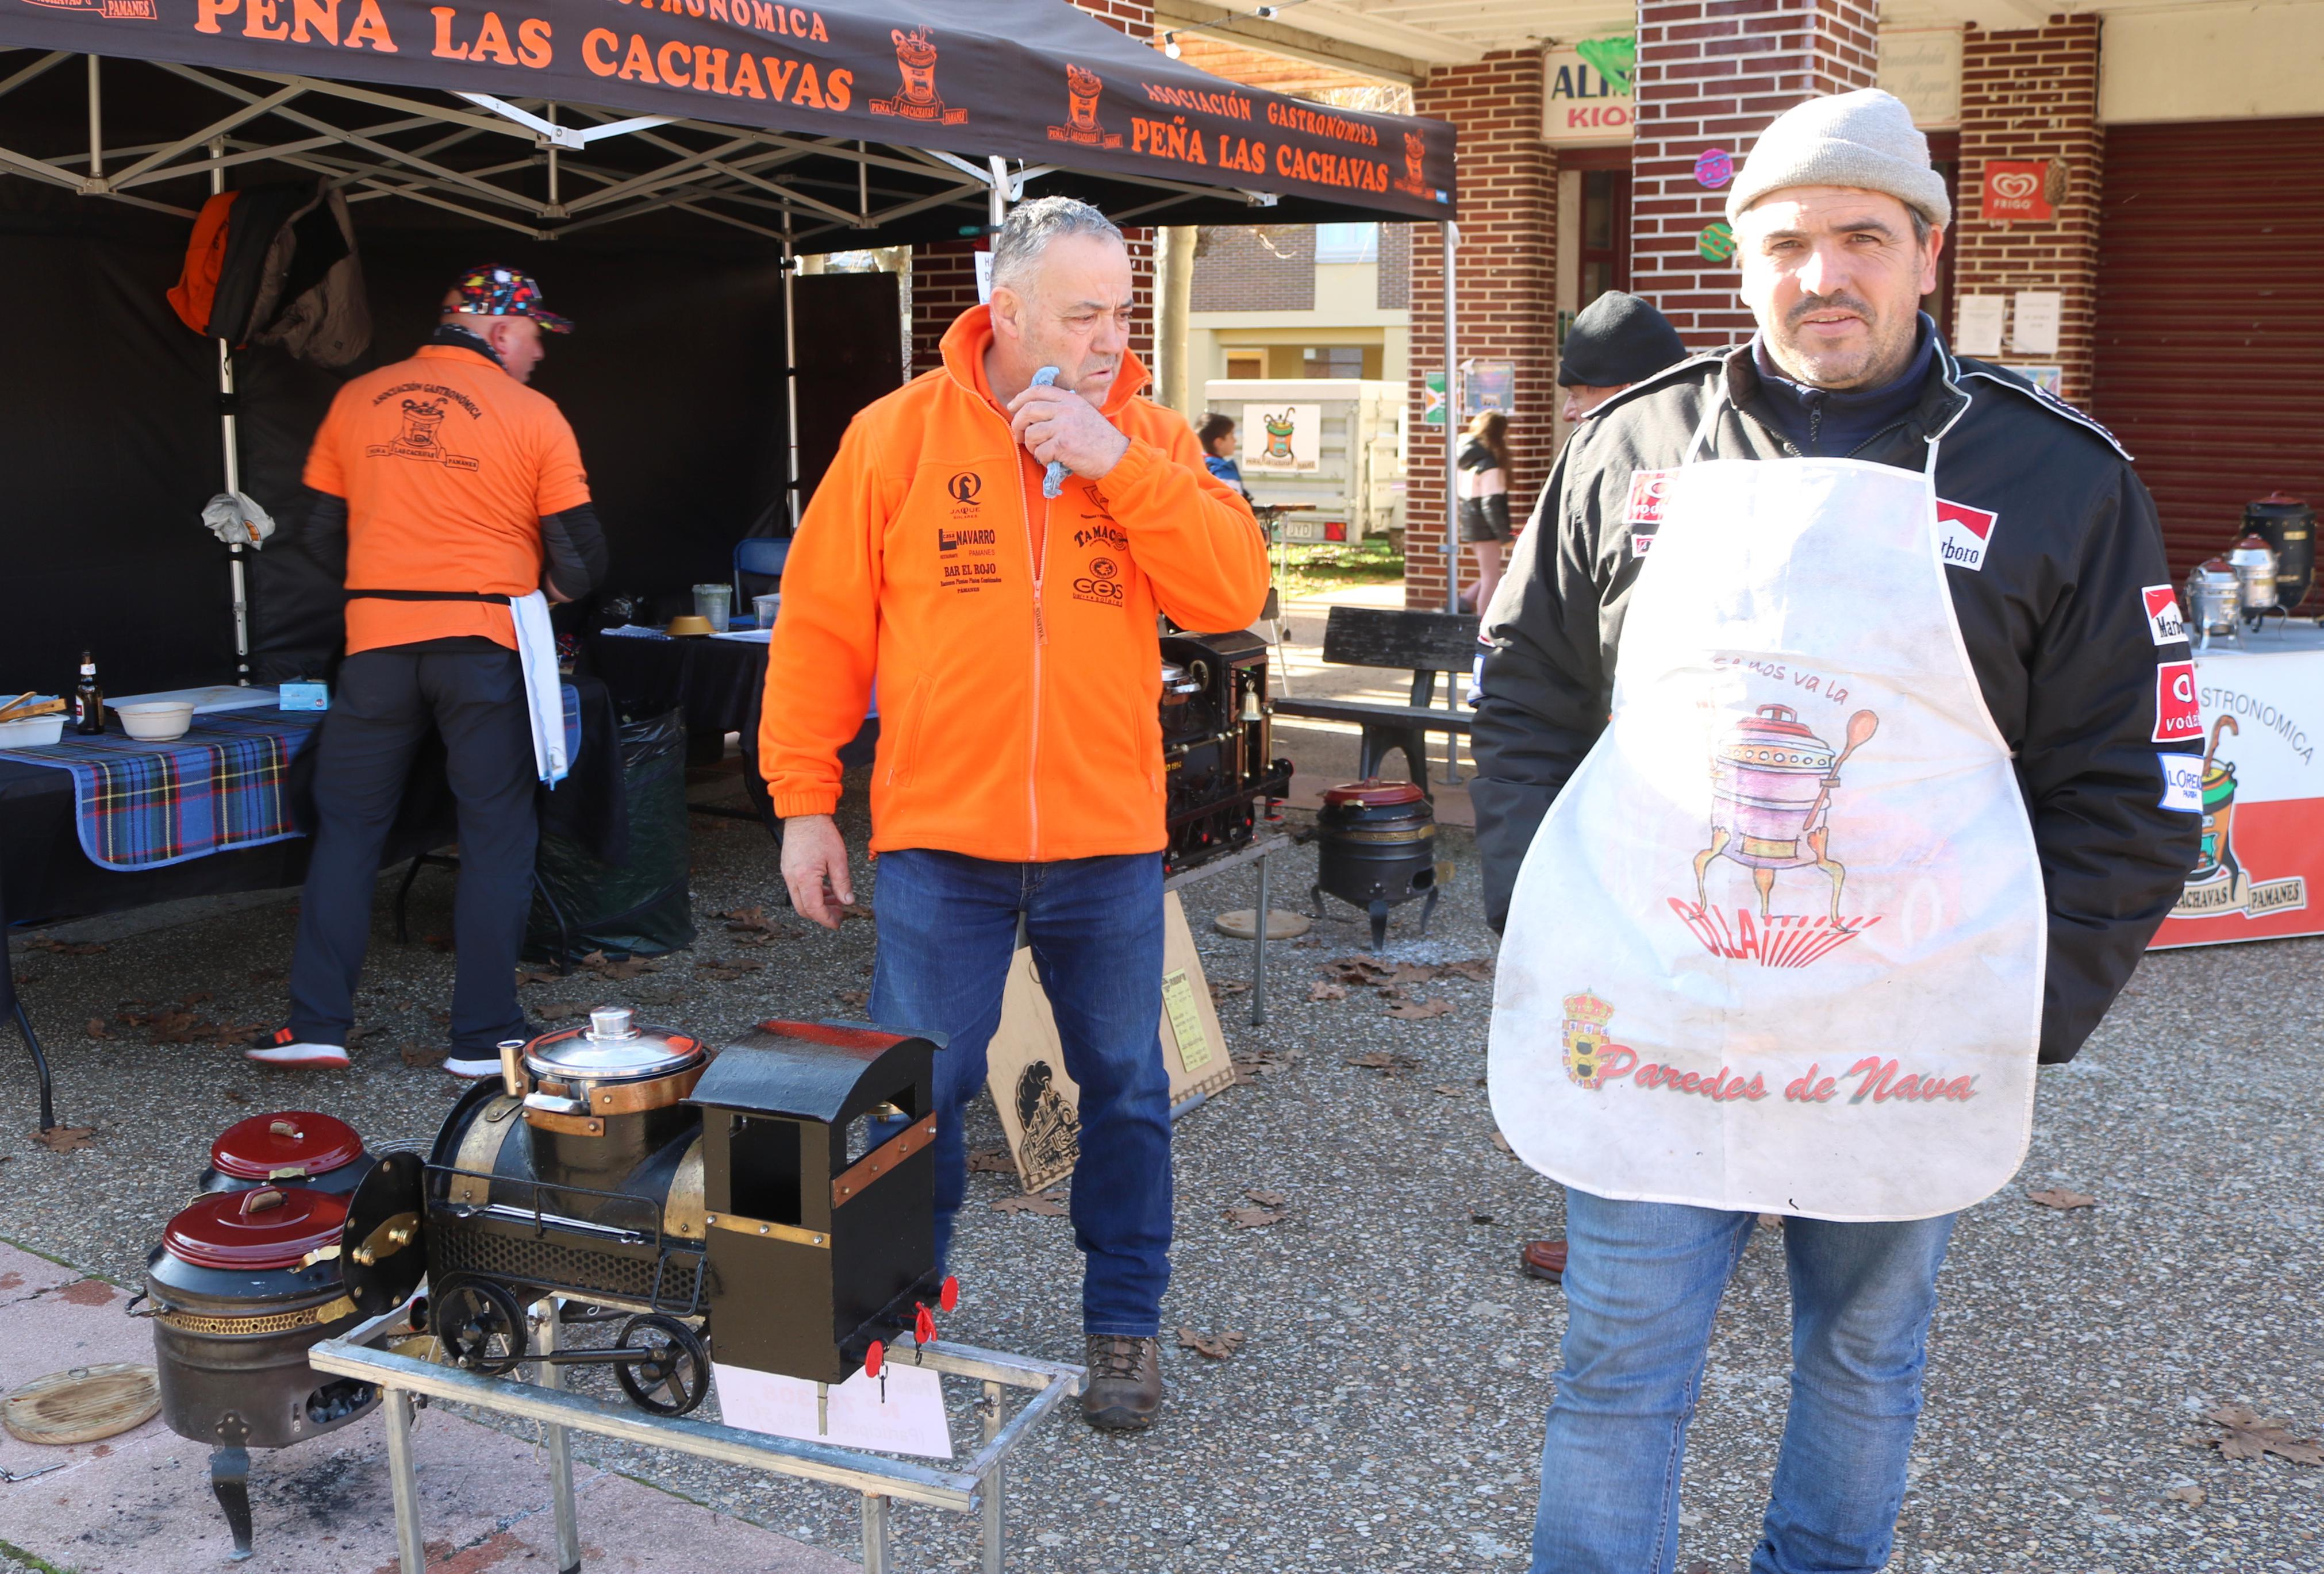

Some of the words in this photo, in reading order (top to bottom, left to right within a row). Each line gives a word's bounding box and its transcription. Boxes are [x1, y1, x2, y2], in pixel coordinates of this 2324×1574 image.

[108, 1, 149, 16] PAMANES
[431, 6, 552, 68] LAS
[582, 27, 854, 111] CACHAVAS
[1550, 64, 1633, 101] ALI
[871, 102, 890, 113] PEÑA
[1141, 82, 1252, 121] ASOCIACIÓN
[1131, 116, 1207, 164] PEÑA
[1218, 134, 1266, 174] LAS
[1276, 144, 1389, 193] CACHAVAS
[957, 529, 996, 546] NAVARRO
[944, 565, 961, 577] BAR
[962, 565, 973, 575] EL
[974, 563, 996, 575] ROJO
[1795, 671, 1820, 692] va
[2252, 882, 2299, 909] PAMANES
[1595, 1043, 1768, 1102] Paredes
[1784, 1063, 1838, 1102] de
[1847, 1055, 1980, 1103] Nava
